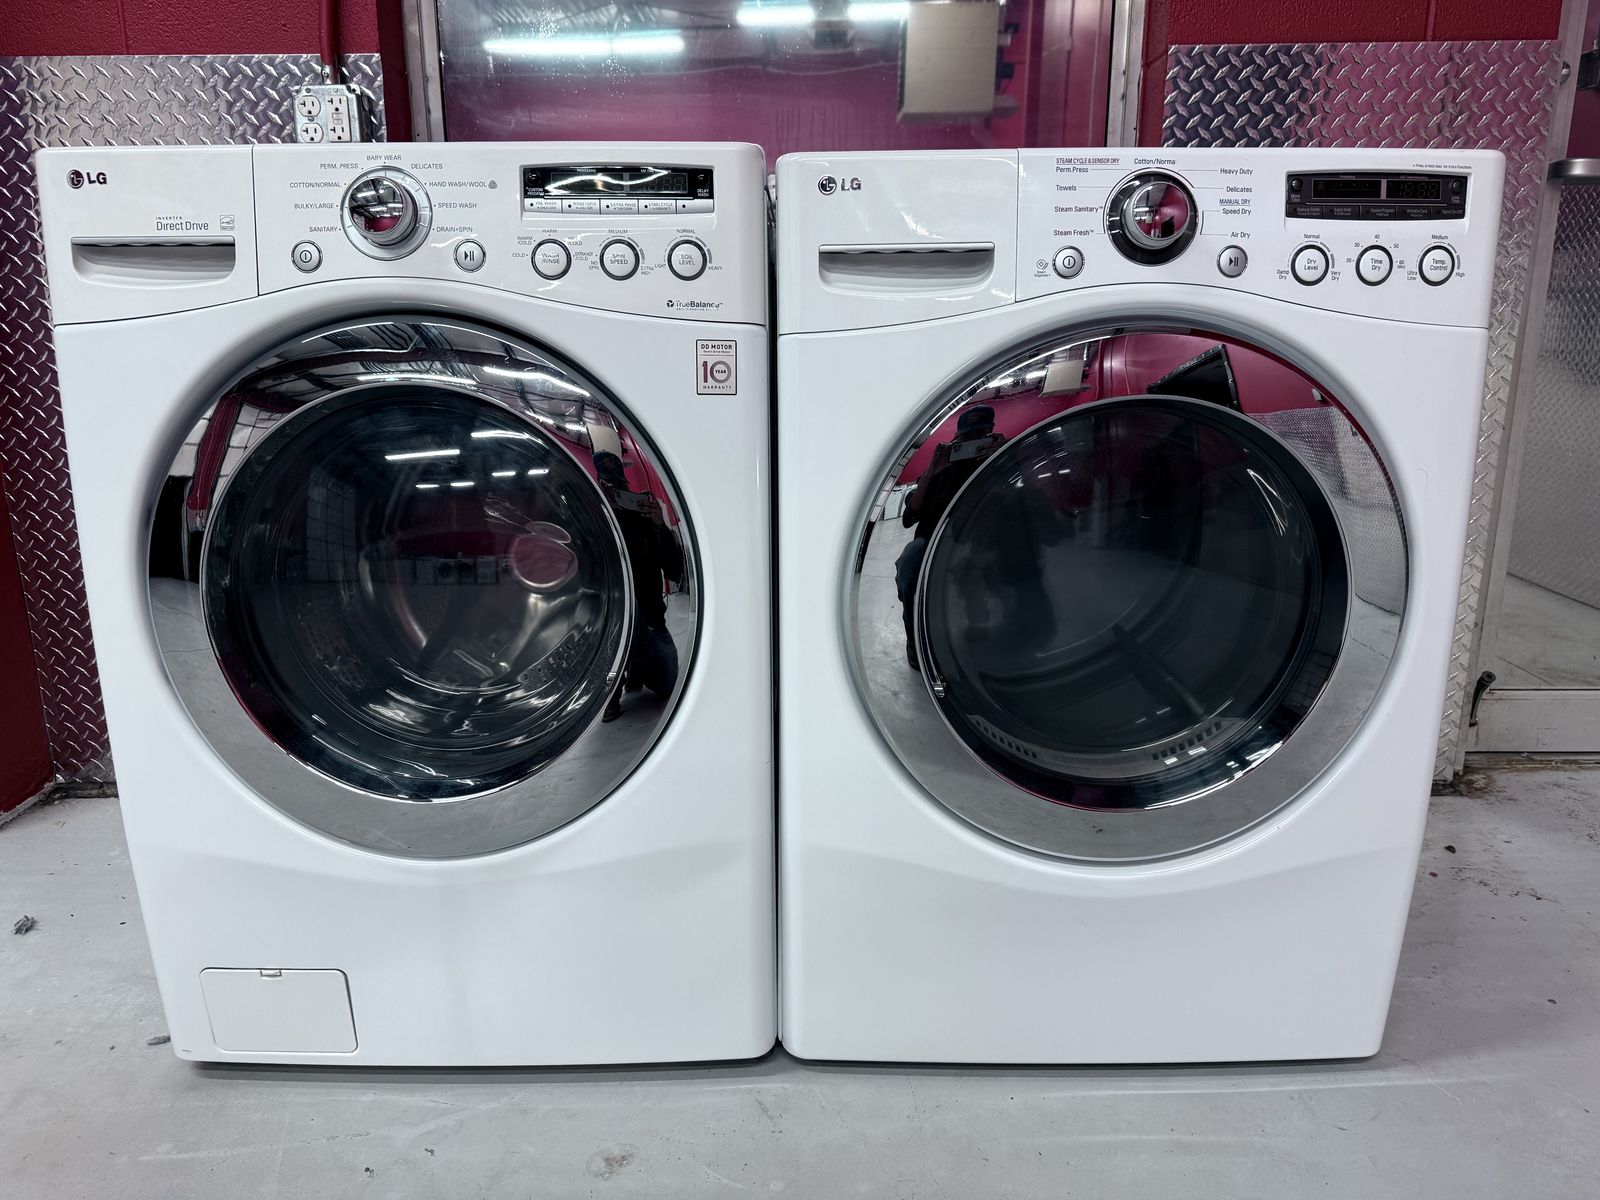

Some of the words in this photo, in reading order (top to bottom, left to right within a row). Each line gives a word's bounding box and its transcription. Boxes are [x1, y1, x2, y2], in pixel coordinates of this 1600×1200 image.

[86, 172, 107, 185] LG
[841, 177, 861, 191] LG
[156, 221, 184, 231] Direct
[186, 221, 209, 231] Drive
[702, 360, 731, 383] 10
